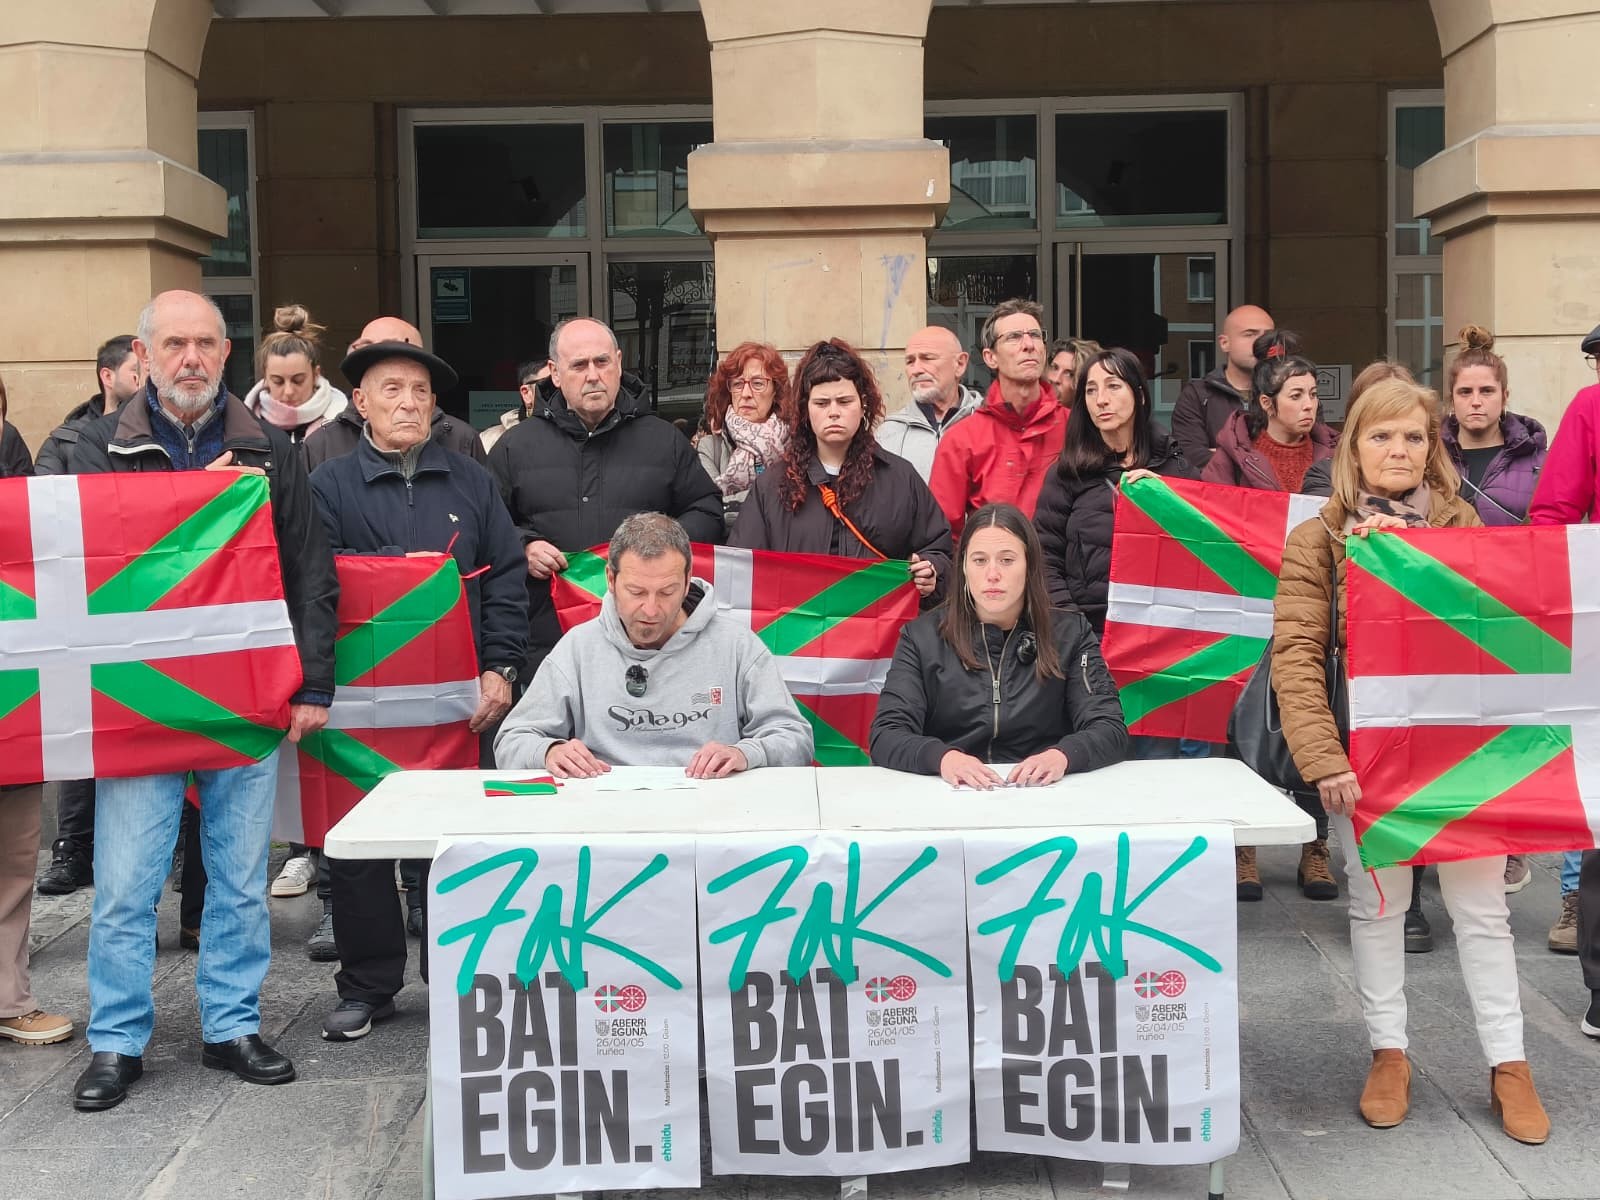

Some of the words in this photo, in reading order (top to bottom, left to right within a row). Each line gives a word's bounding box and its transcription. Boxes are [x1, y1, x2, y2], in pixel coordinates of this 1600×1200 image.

[458, 971, 589, 1074] BAT
[730, 965, 860, 1067] BAT
[882, 1016, 919, 1026] EGUNA
[1000, 959, 1129, 1057] BAT
[1151, 1012, 1188, 1021] EGUNA
[596, 1037, 645, 1047] 26/04/05
[611, 1027, 648, 1036] EGUNA
[867, 1026, 916, 1038] 26/04/05
[1136, 1022, 1185, 1032] 26/04/05
[735, 1058, 924, 1156] EGIN.
[1001, 1053, 1192, 1144] EGIN.
[461, 1069, 653, 1174] EGIN.
[932, 1109, 943, 1144] ehbildu
[1200, 1106, 1211, 1142] ehbildu
[661, 1123, 672, 1162] ehbildu
